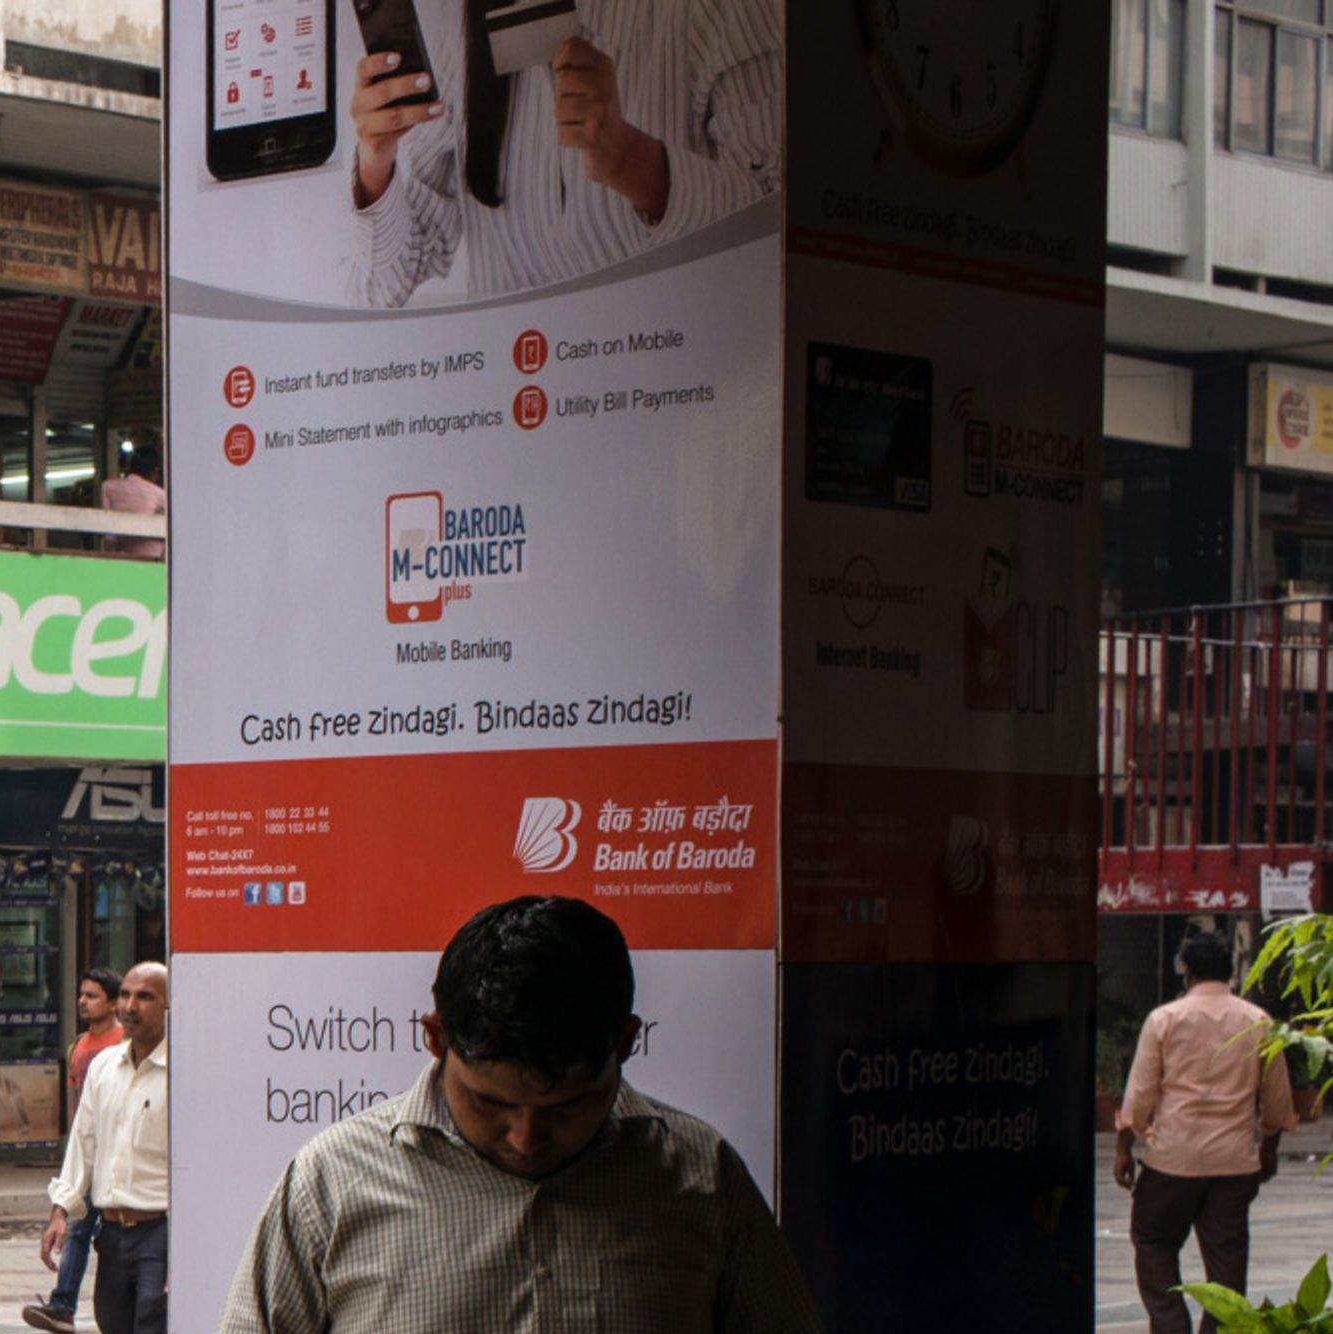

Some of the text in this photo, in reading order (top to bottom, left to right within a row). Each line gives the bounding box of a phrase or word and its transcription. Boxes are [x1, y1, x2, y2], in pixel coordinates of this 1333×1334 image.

[91, 270, 137, 293] RAJA
[556, 330, 684, 361] Cash on Mobile
[264, 352, 485, 394] Instant fund transfers by IMPS
[556, 382, 715, 421] Utility Bill Payments
[264, 408, 503, 450] Mini Statement with infographics
[444, 503, 525, 541] BARODA
[392, 537, 526, 583] M-CONNECT
[443, 579, 472, 606] plus
[396, 638, 512, 666] Mobile Banking
[241, 692, 693, 746] Cash free zindagi. Bindaas zindagi!
[60, 768, 166, 823] ASU
[186, 810, 254, 823] Call toll free no.
[264, 807, 286, 820] 1800
[288, 807, 301, 819] 22
[317, 806, 330, 818] 44
[597, 799, 634, 833] बैंक
[692, 795, 754, 837] बड़ौदा
[193, 826, 209, 837] am
[216, 825, 228, 836] 10
[229, 826, 245, 838] pm
[264, 823, 286, 836] 1800
[305, 823, 317, 834] 44
[186, 850, 206, 862] Web
[186, 864, 297, 877] www.bankofbaroda.co.in
[594, 839, 756, 872] Bank of Baroda
[185, 887, 240, 899] Follow us on
[594, 880, 734, 897] India's International Bank
[266, 1004, 395, 1053] Switch
[837, 1040, 1051, 1094] Cash free zindagi.
[849, 1109, 1037, 1165] Bindaas zindagi!
